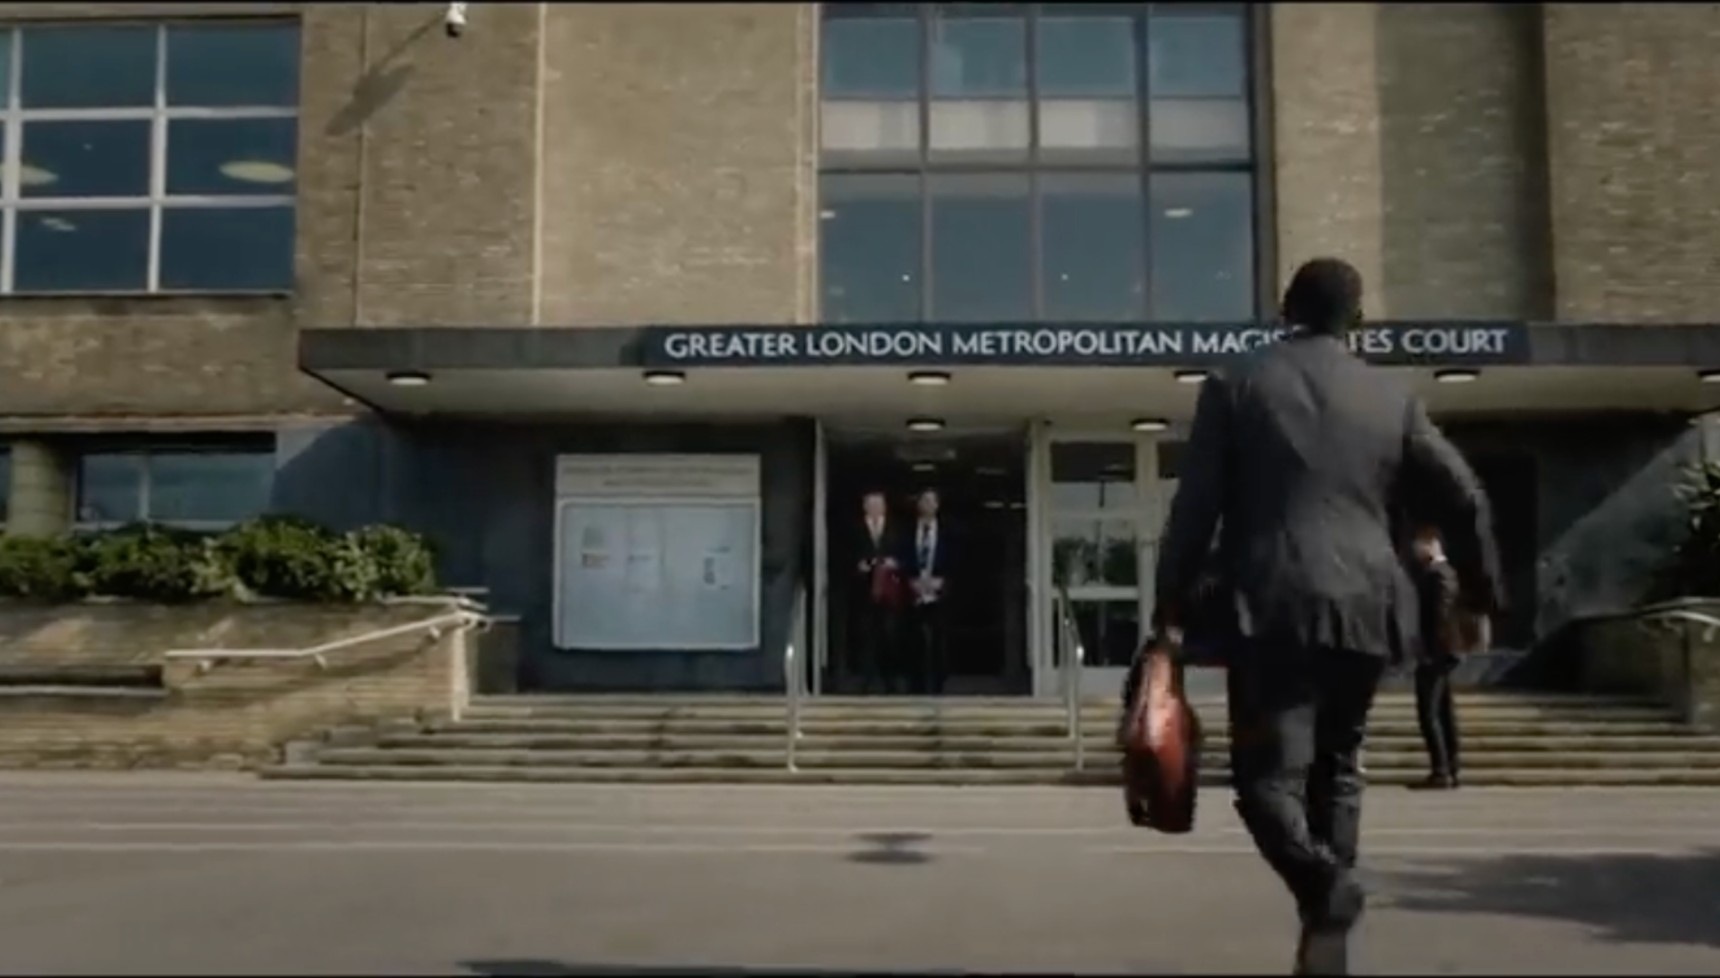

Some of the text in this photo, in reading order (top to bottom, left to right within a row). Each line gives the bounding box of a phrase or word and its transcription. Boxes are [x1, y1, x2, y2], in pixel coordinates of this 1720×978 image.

[664, 333, 798, 358] GREATER
[805, 332, 943, 356] LONDON
[951, 330, 1183, 355] METROPOLITAN
[1401, 328, 1509, 354] COURT
